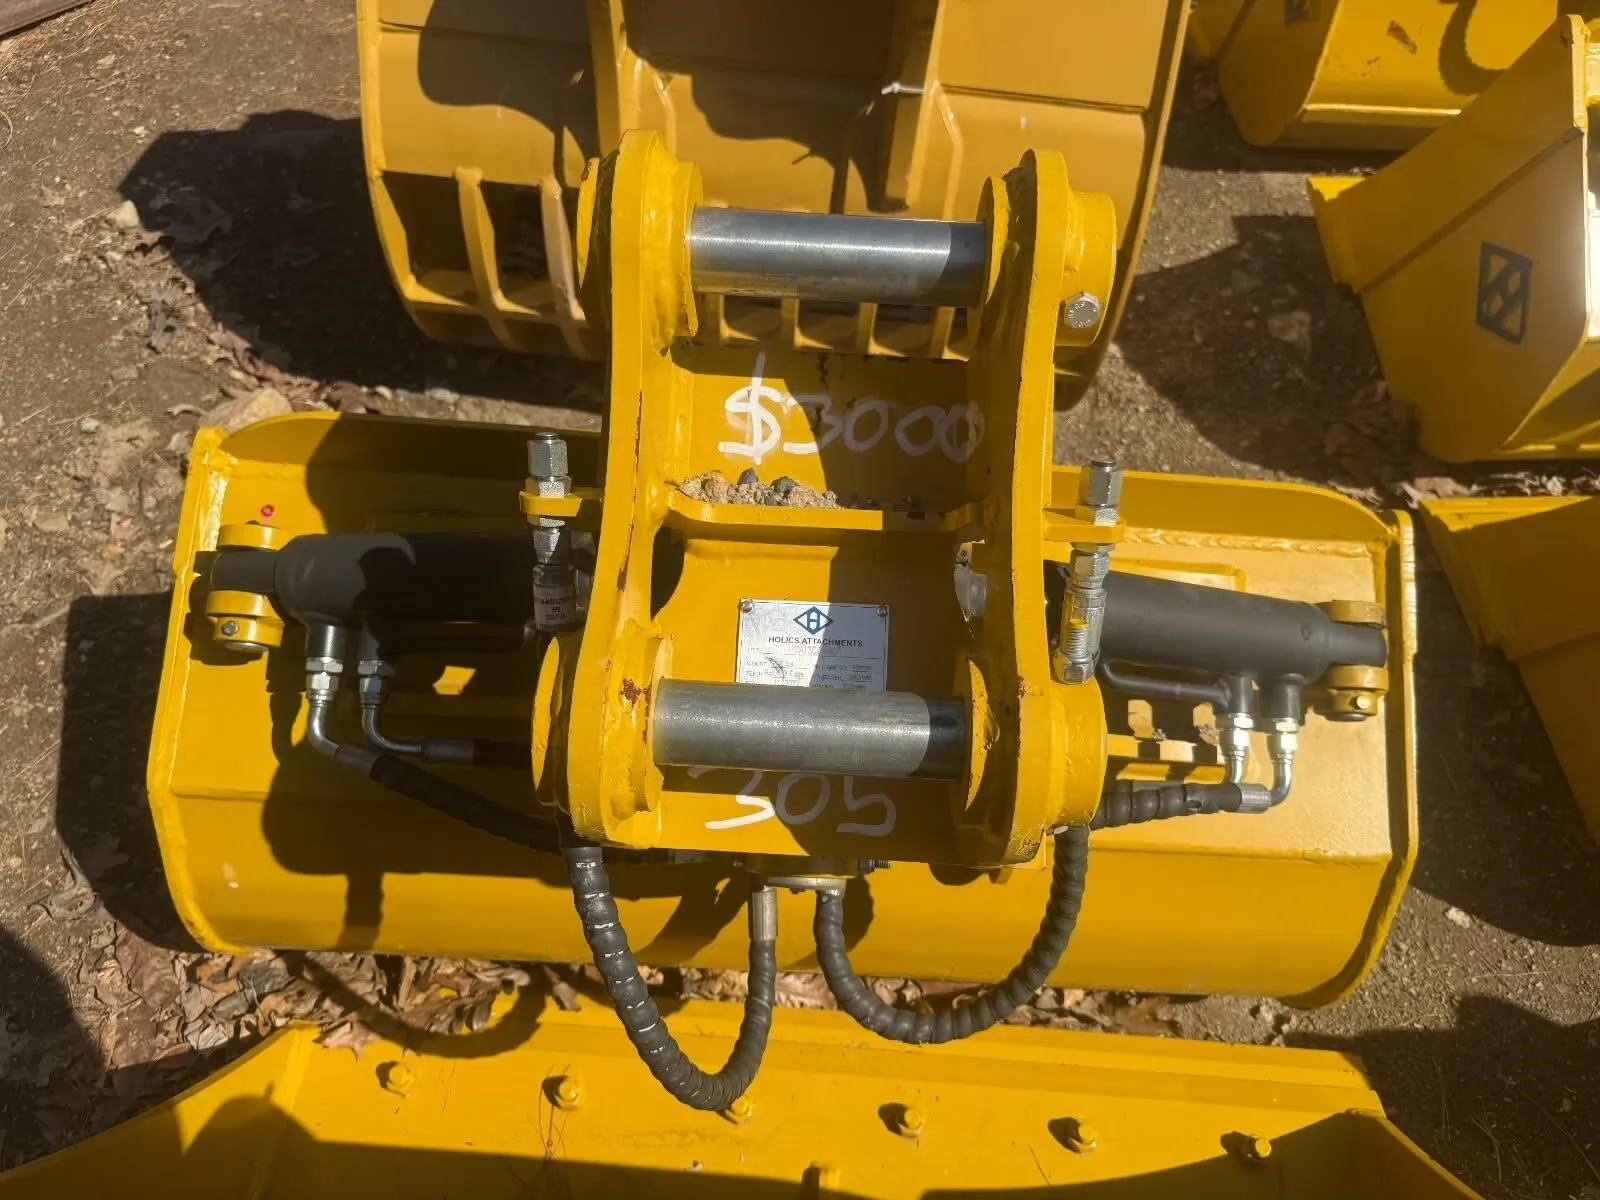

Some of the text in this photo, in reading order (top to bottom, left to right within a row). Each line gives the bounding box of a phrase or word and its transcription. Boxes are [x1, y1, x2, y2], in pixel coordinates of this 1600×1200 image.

[717, 352, 985, 464] $3000
[768, 636, 864, 648] HOLICS ATTACHMENTS
[687, 768, 896, 836] 305
